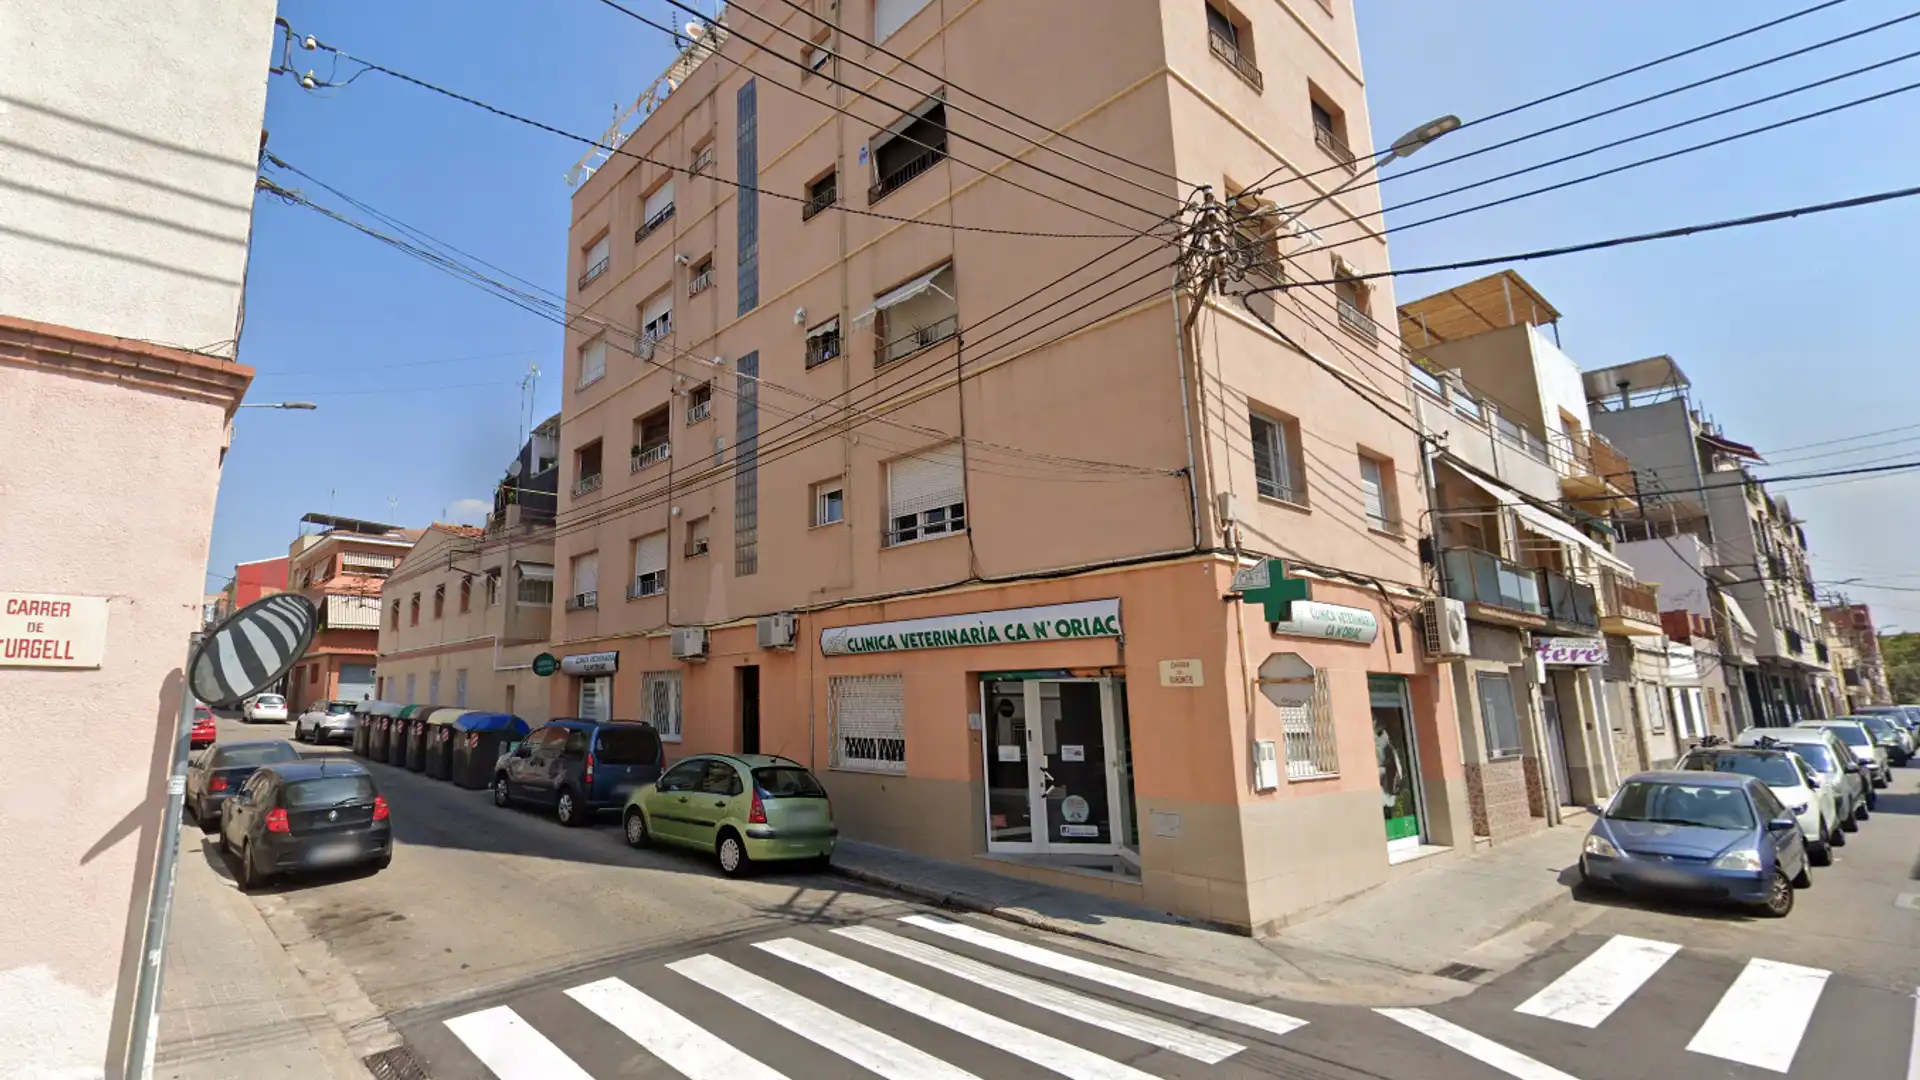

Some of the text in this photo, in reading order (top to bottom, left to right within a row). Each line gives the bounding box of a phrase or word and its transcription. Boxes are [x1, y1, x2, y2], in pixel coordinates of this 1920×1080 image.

[6, 599, 71, 618] CARRER
[27, 621, 44, 633] DE
[847, 633, 897, 653] CLINICA
[1004, 623, 1030, 641] CA
